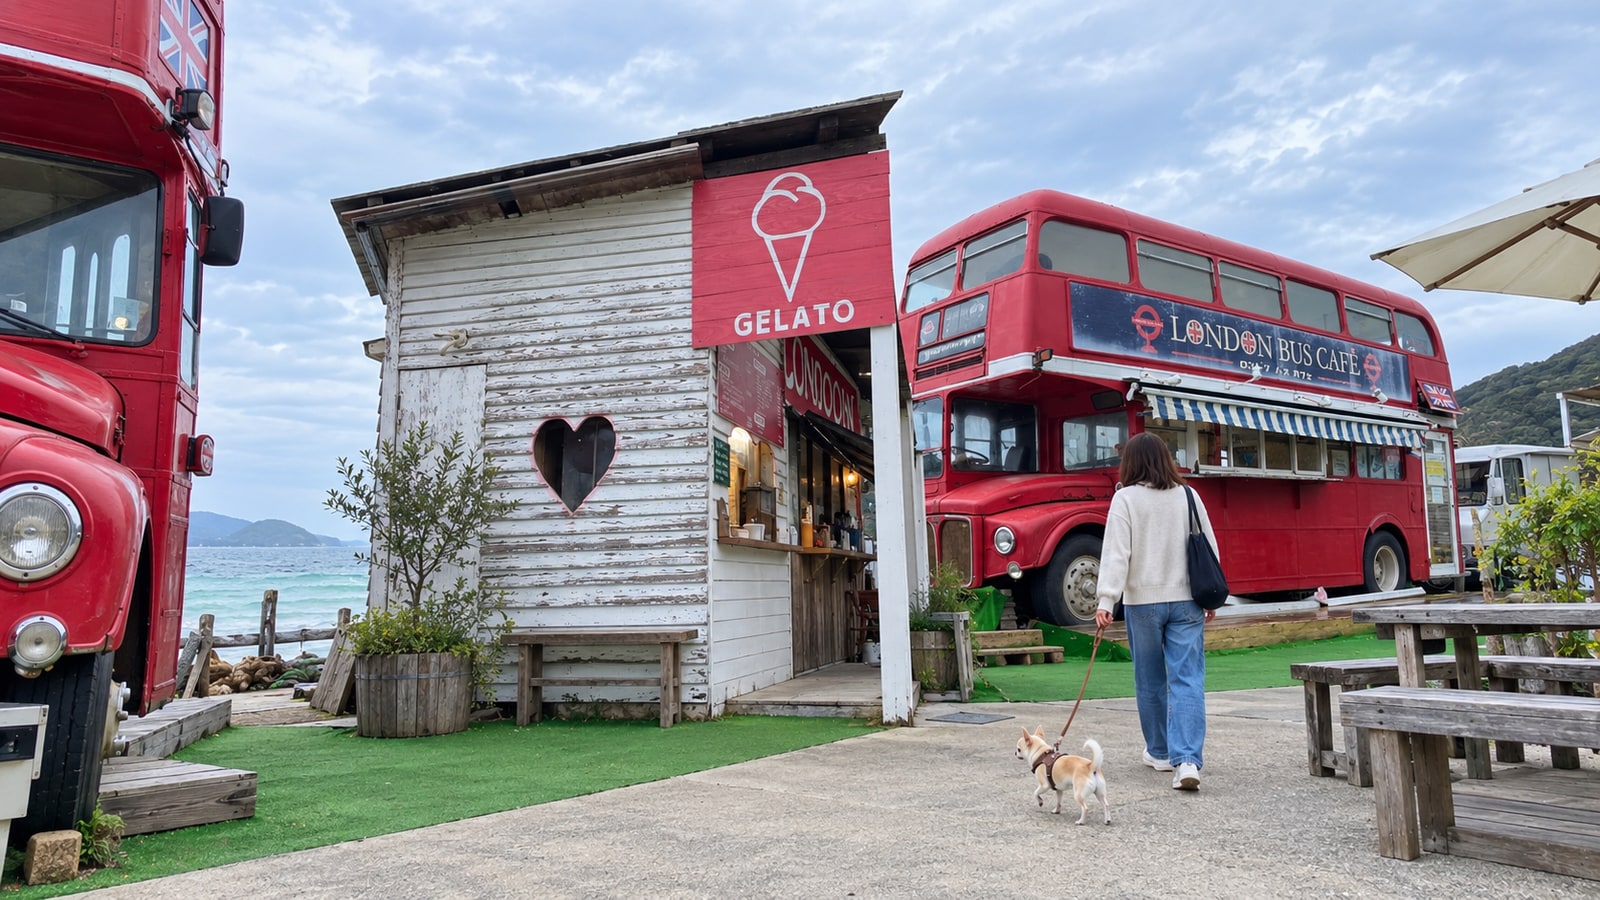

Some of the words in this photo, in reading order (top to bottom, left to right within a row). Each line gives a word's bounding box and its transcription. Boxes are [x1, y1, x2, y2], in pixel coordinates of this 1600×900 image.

[734, 299, 855, 336] GELATO
[1170, 314, 1272, 360] LONDON
[1277, 337, 1313, 366] BUS
[1316, 347, 1361, 376] CAFÉ
